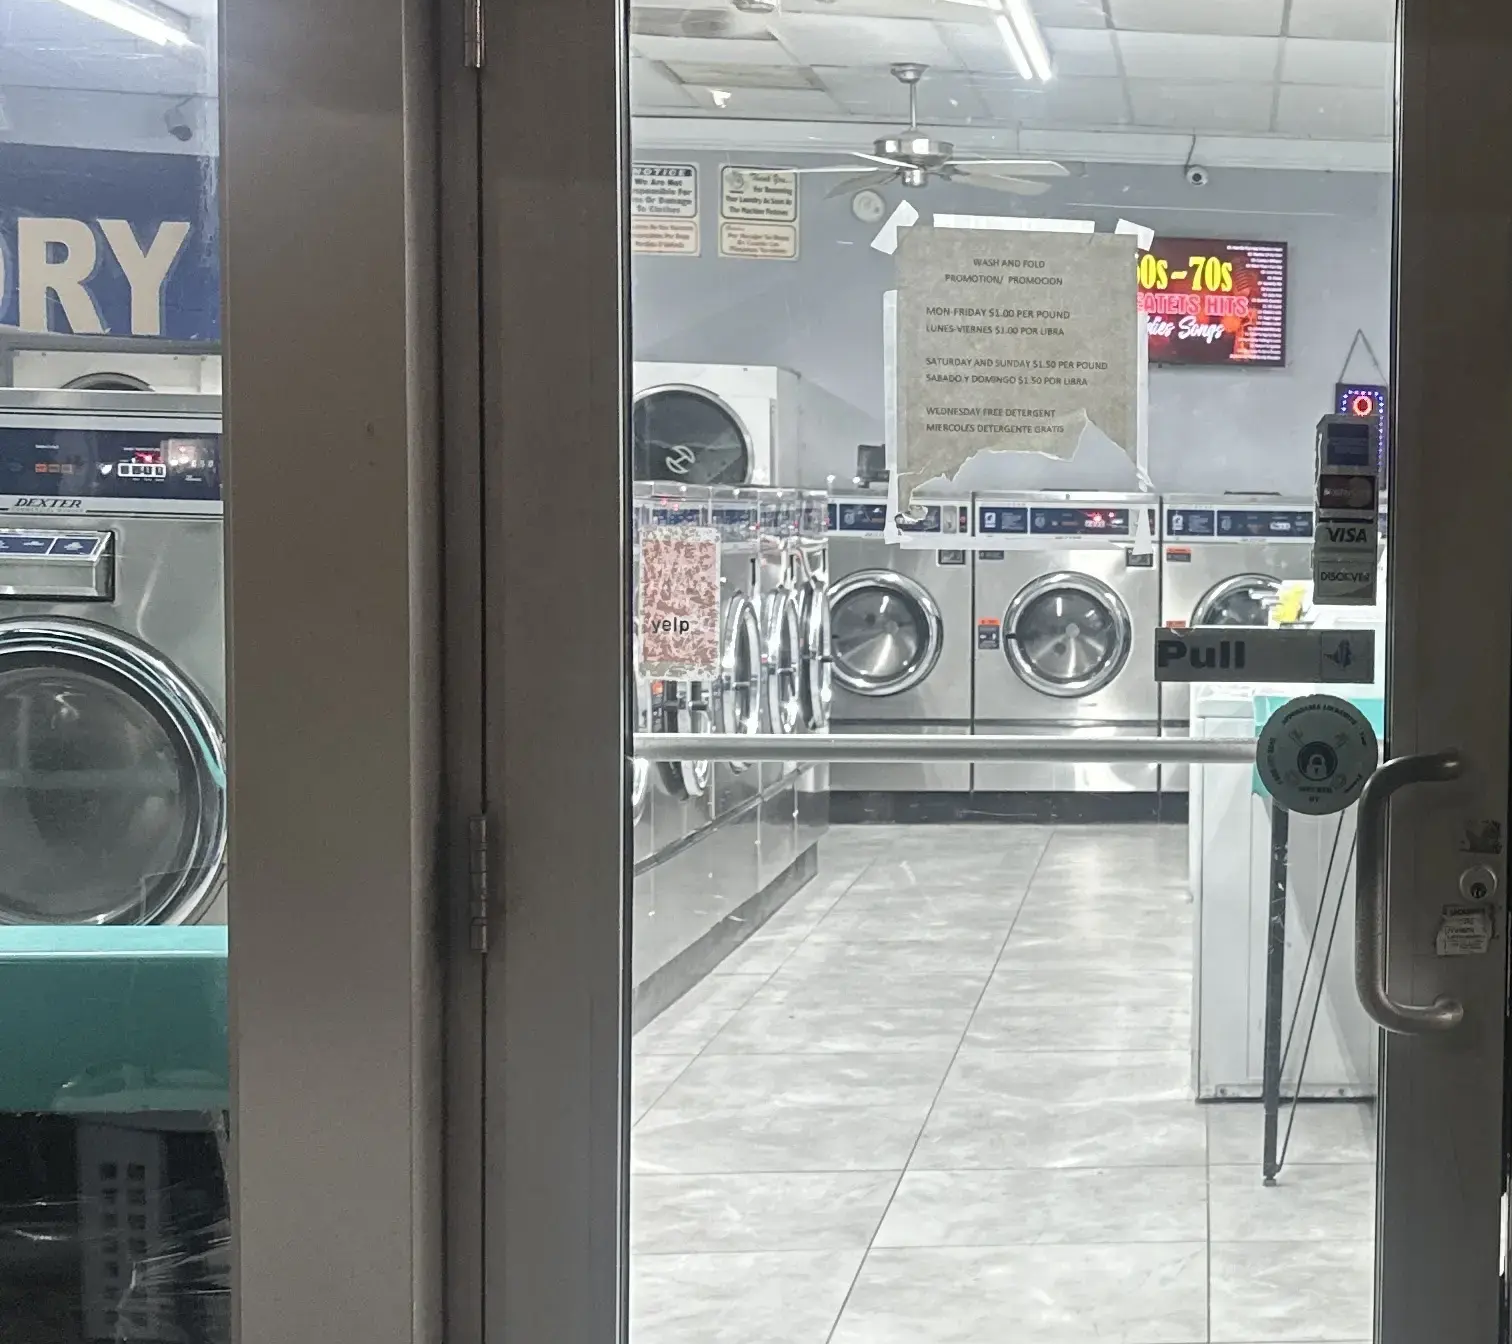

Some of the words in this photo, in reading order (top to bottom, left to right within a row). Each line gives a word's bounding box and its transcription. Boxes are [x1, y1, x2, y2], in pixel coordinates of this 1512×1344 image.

[973, 258, 1000, 267] WASH
[1001, 259, 1021, 268] AND
[1022, 260, 1046, 269] FOLD
[0, 217, 191, 336] RY
[1204, 294, 1249, 318] HITS
[988, 308, 1015, 318] $1.00
[1016, 309, 1034, 318] PER
[1036, 310, 1071, 320] POUND
[994, 326, 1019, 335] $1.00
[1020, 327, 1038, 336] POR
[1040, 327, 1065, 337] LIBRA
[1177, 314, 1225, 345] Songs
[926, 358, 972, 367] SATURDAY
[973, 358, 994, 367] AND
[995, 359, 1031, 368] SUNDAY
[1032, 359, 1057, 369] $1.50
[1058, 360, 1075, 369] PER
[1076, 361, 1108, 370] POUND
[926, 374, 962, 383] SABADO
[971, 375, 1016, 384] DOMINGO
[1043, 376, 1062, 385] POR
[1063, 377, 1088, 386] LIBRA
[926, 407, 981, 416] WEDNESDAY
[982, 408, 1003, 417] FREE
[1004, 408, 1056, 418] DETERGENT
[926, 423, 975, 432] MIERCOLES
[977, 424, 1032, 433] DETERGENTE
[1034, 425, 1064, 434] GRATIS
[15, 498, 82, 508] DEXTER
[1327, 527, 1368, 543] VISA
[1320, 570, 1371, 582] DISCOVER
[651, 616, 690, 634] yelp
[1157, 639, 1246, 670] Pull
